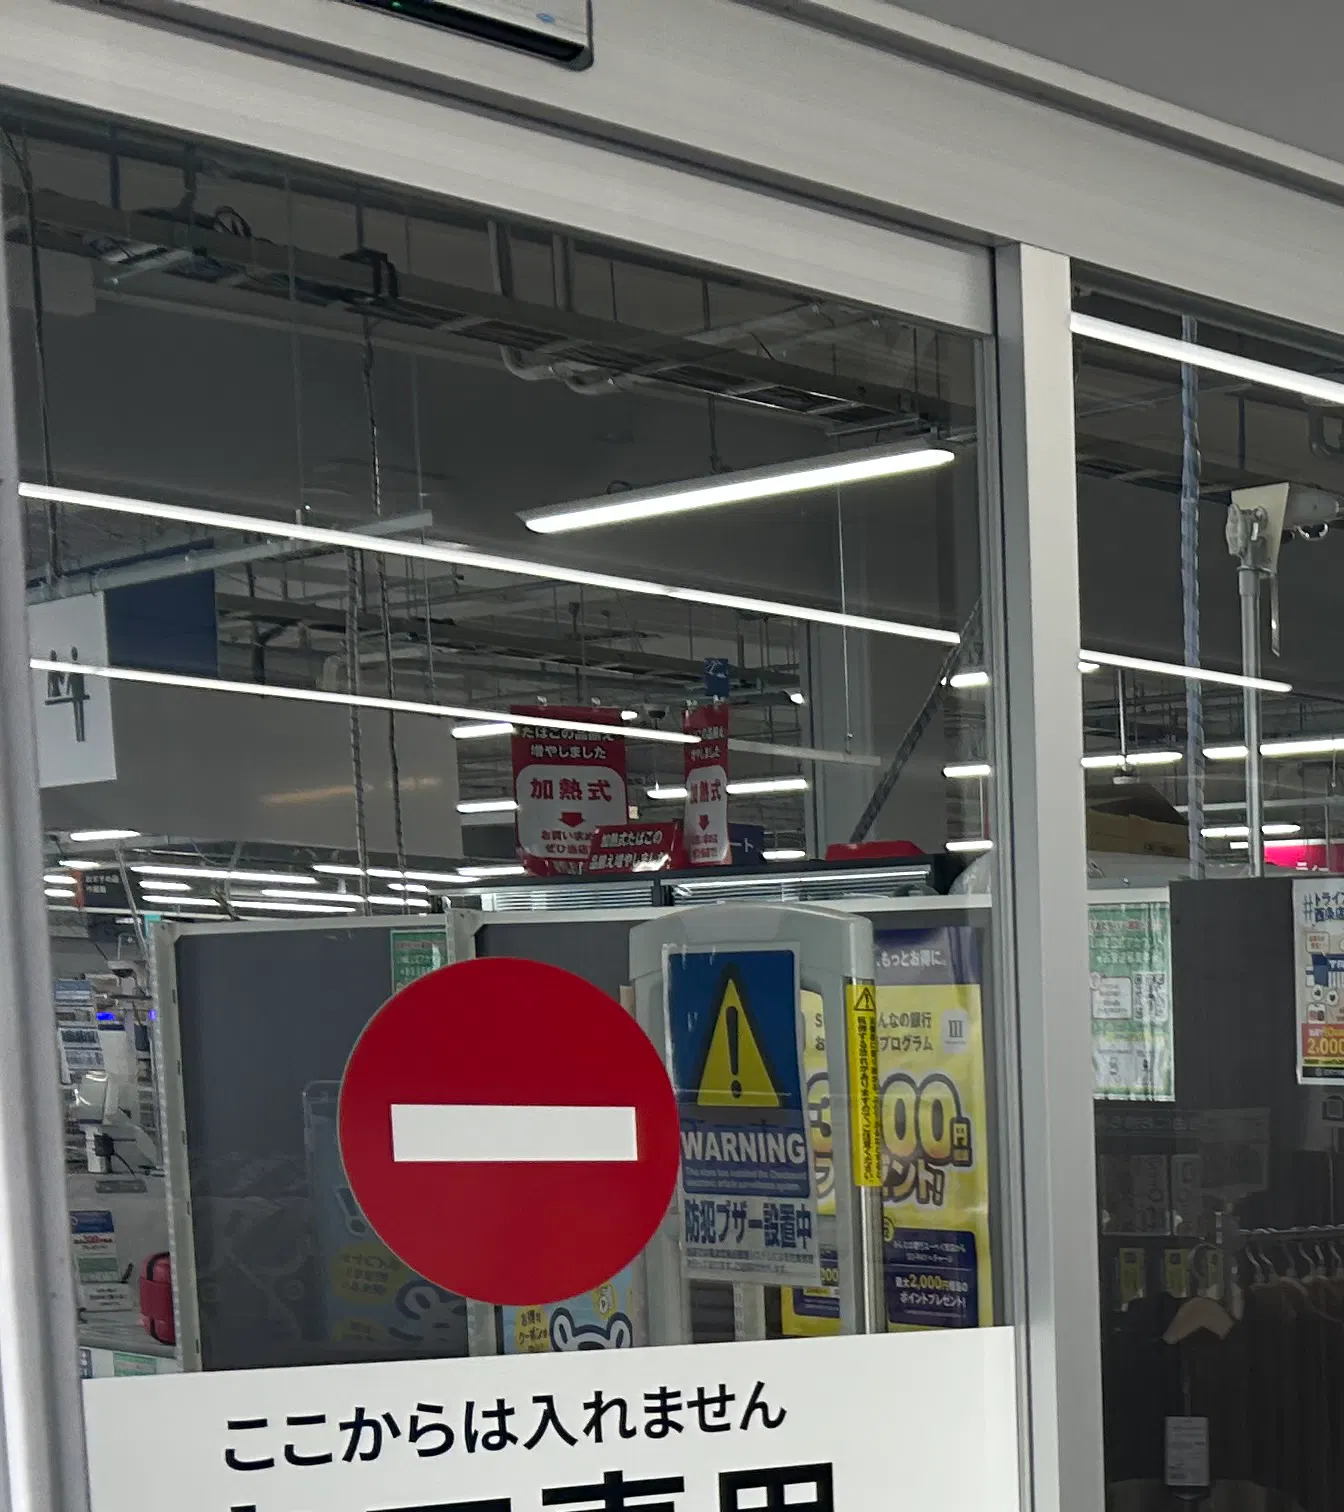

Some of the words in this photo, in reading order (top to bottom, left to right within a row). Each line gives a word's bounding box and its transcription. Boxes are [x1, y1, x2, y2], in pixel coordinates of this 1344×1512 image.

[530, 778, 613, 802] 加熱式
[877, 1011, 932, 1029] んなの銀行
[879, 1036, 933, 1052] プログラム
[680, 1131, 806, 1164] WARNING
[684, 1199, 812, 1250] 防犯ブザー設置中
[224, 1380, 787, 1472] ここからは入れません
